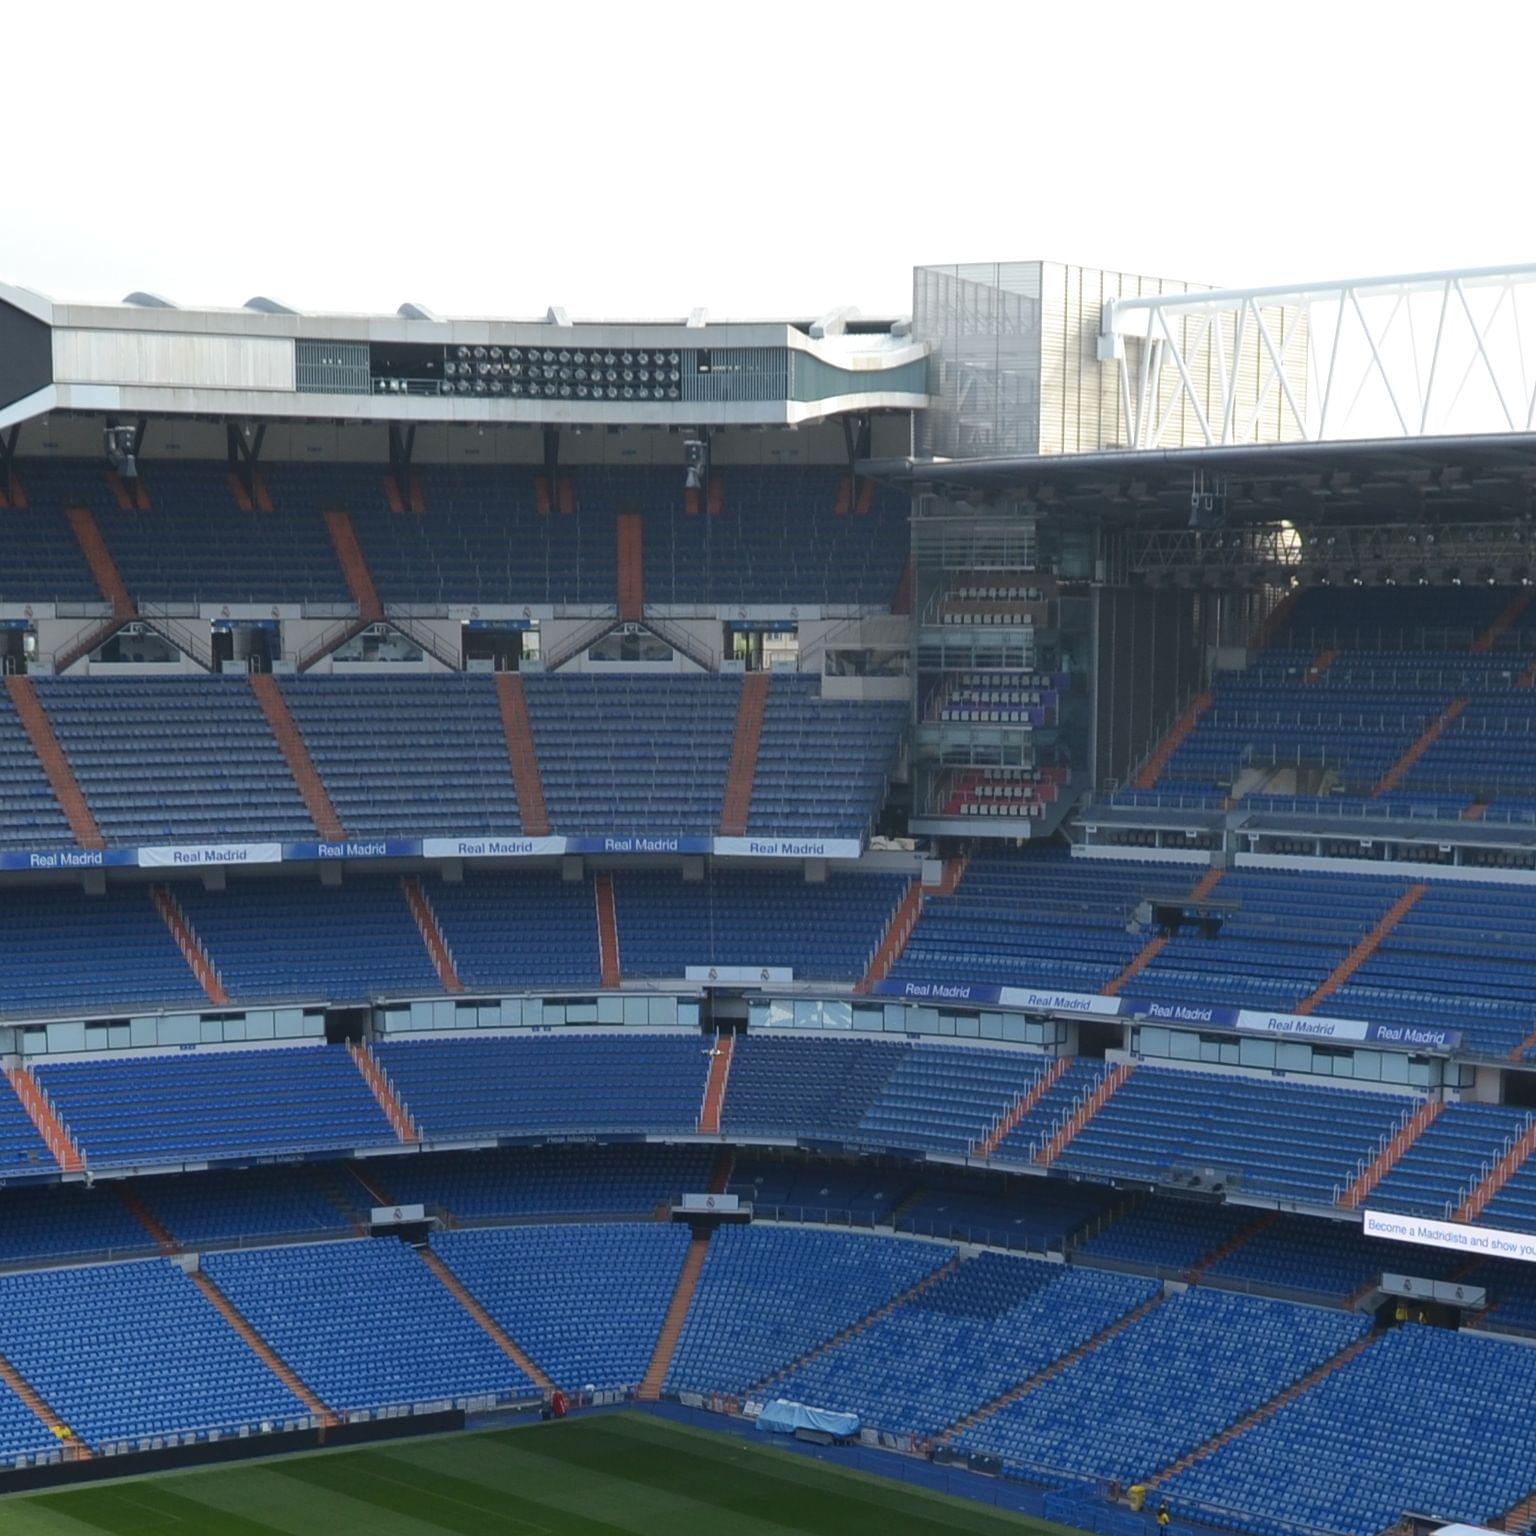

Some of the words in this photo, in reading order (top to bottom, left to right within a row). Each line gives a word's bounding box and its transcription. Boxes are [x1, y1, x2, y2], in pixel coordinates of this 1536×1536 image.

[318, 844, 344, 857] Real
[347, 843, 385, 855] Madrid
[458, 843, 485, 854] Real
[488, 841, 532, 853] Madrid
[605, 839, 632, 850] Real
[635, 838, 677, 850] Madrid
[750, 843, 778, 854] Real
[782, 842, 824, 854] Madrid
[30, 852, 57, 865] Real
[61, 851, 102, 864] Madrid
[173, 850, 200, 862] Real
[204, 849, 246, 861] Madrid
[906, 983, 928, 995] Real
[931, 985, 970, 998] Madrid
[1028, 995, 1053, 1007] Real
[1056, 997, 1090, 1010] Madrid
[1150, 1003, 1174, 1017] Real
[1177, 1006, 1211, 1020] Madrid
[1268, 1018, 1293, 1032] Real
[1295, 1020, 1334, 1035] Madrid
[1377, 1025, 1402, 1041] Real
[1405, 1028, 1444, 1044] Madrid
[1368, 1219, 1407, 1234] Become
[1409, 1228, 1415, 1236] a
[1417, 1227, 1467, 1245] Madridista
[1471, 1236, 1488, 1248] and
[1491, 1238, 1517, 1253] show
